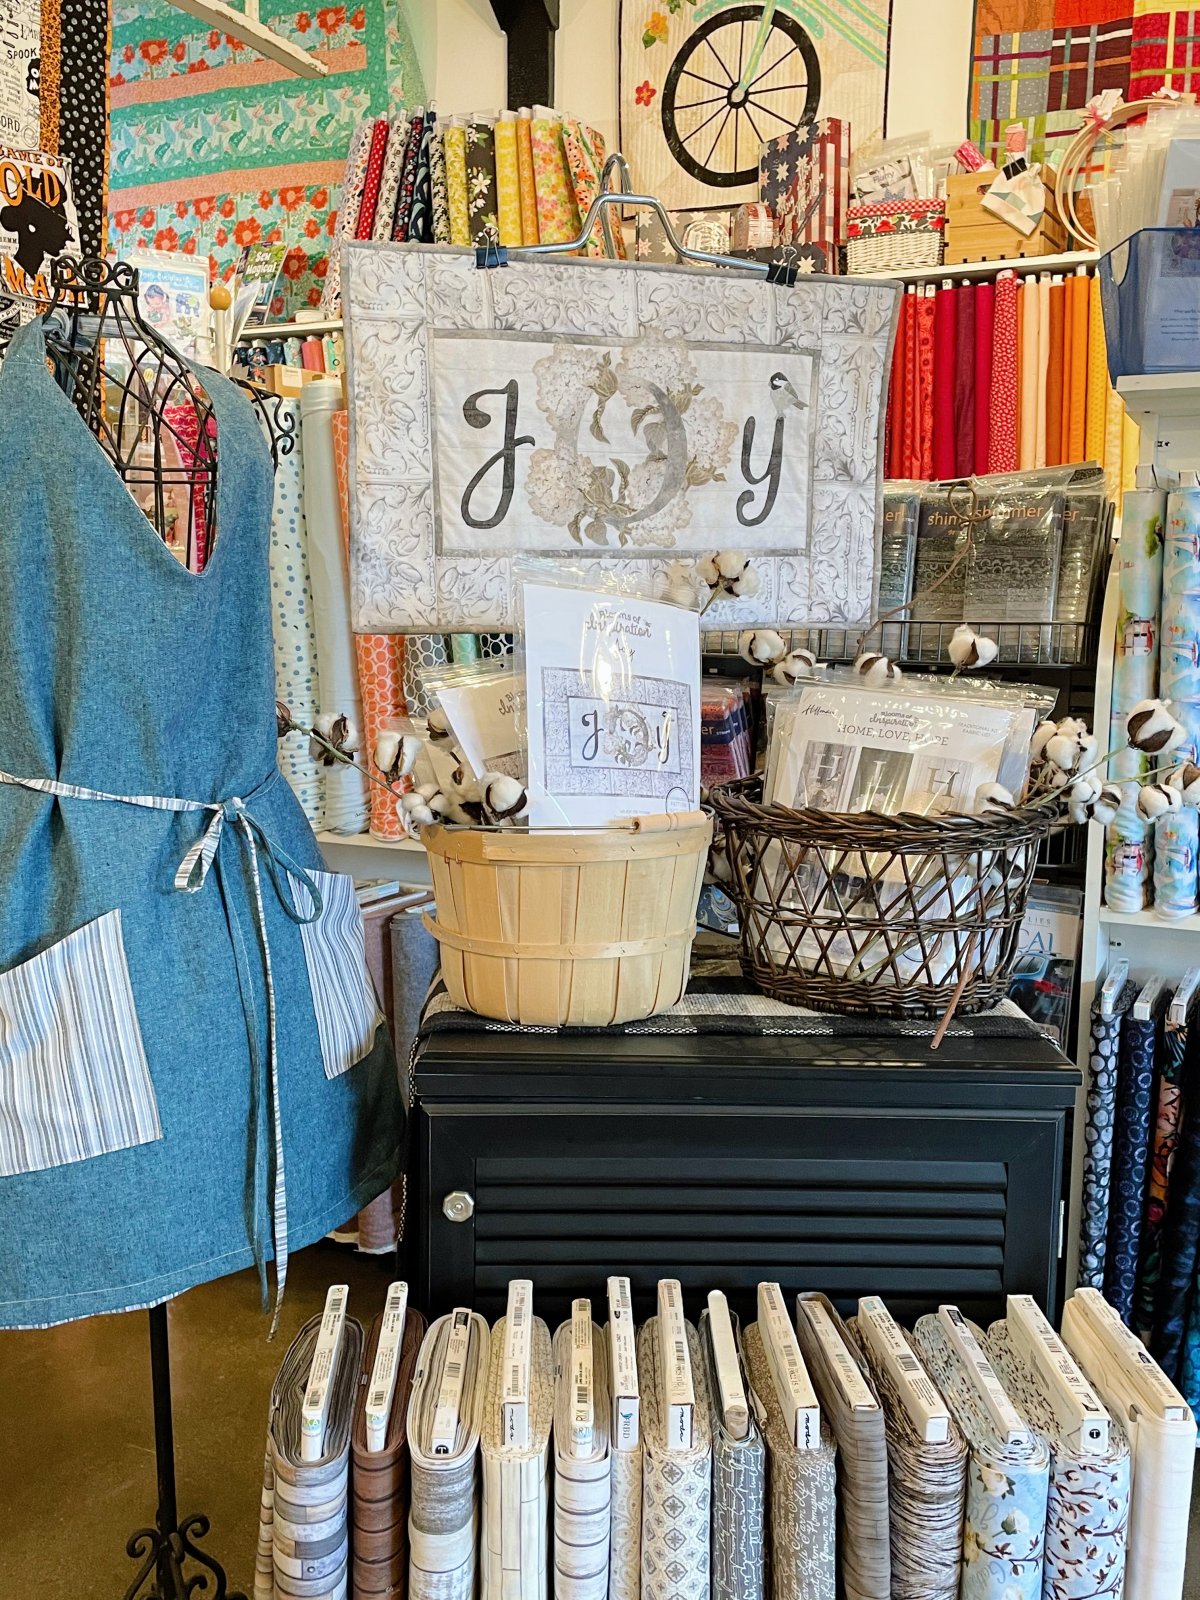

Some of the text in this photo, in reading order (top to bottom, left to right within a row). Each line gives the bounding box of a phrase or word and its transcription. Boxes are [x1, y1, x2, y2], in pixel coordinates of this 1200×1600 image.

[7, 48, 37, 59] SPOOK
[0, 162, 61, 208] OLD
[246, 261, 277, 277] Magical
[975, 505, 1044, 519] shmmer
[878, 728, 912, 742] LOVE,
[622, 1420, 631, 1439] RBD
[679, 1407, 687, 1443] moda
[804, 1412, 812, 1449] moda
[818, 1496, 829, 1512] the
